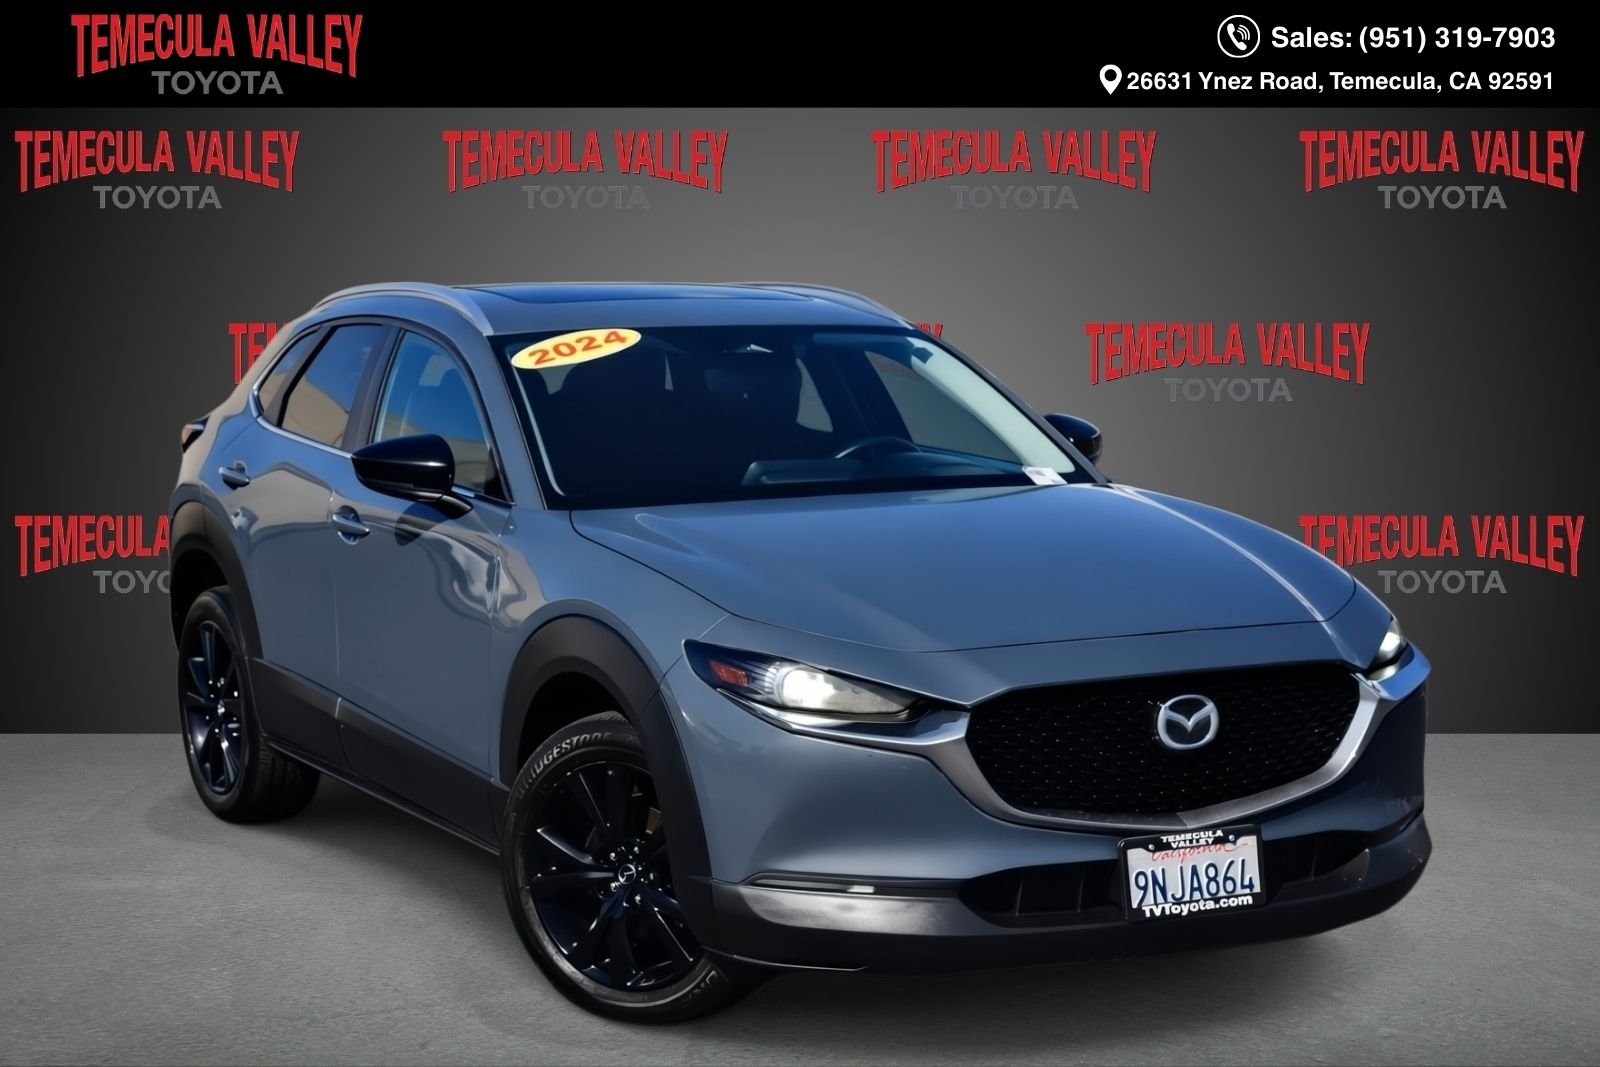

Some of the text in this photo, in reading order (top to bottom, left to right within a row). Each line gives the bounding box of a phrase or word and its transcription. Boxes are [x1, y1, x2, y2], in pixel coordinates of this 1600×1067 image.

[528, 330, 627, 366] 2024
[1160, 830, 1224, 843] TEMECULA
[1170, 838, 1214, 849] VALLEY
[1134, 858, 1255, 909] 9NJA864
[1142, 895, 1254, 917] TVToyota.com
